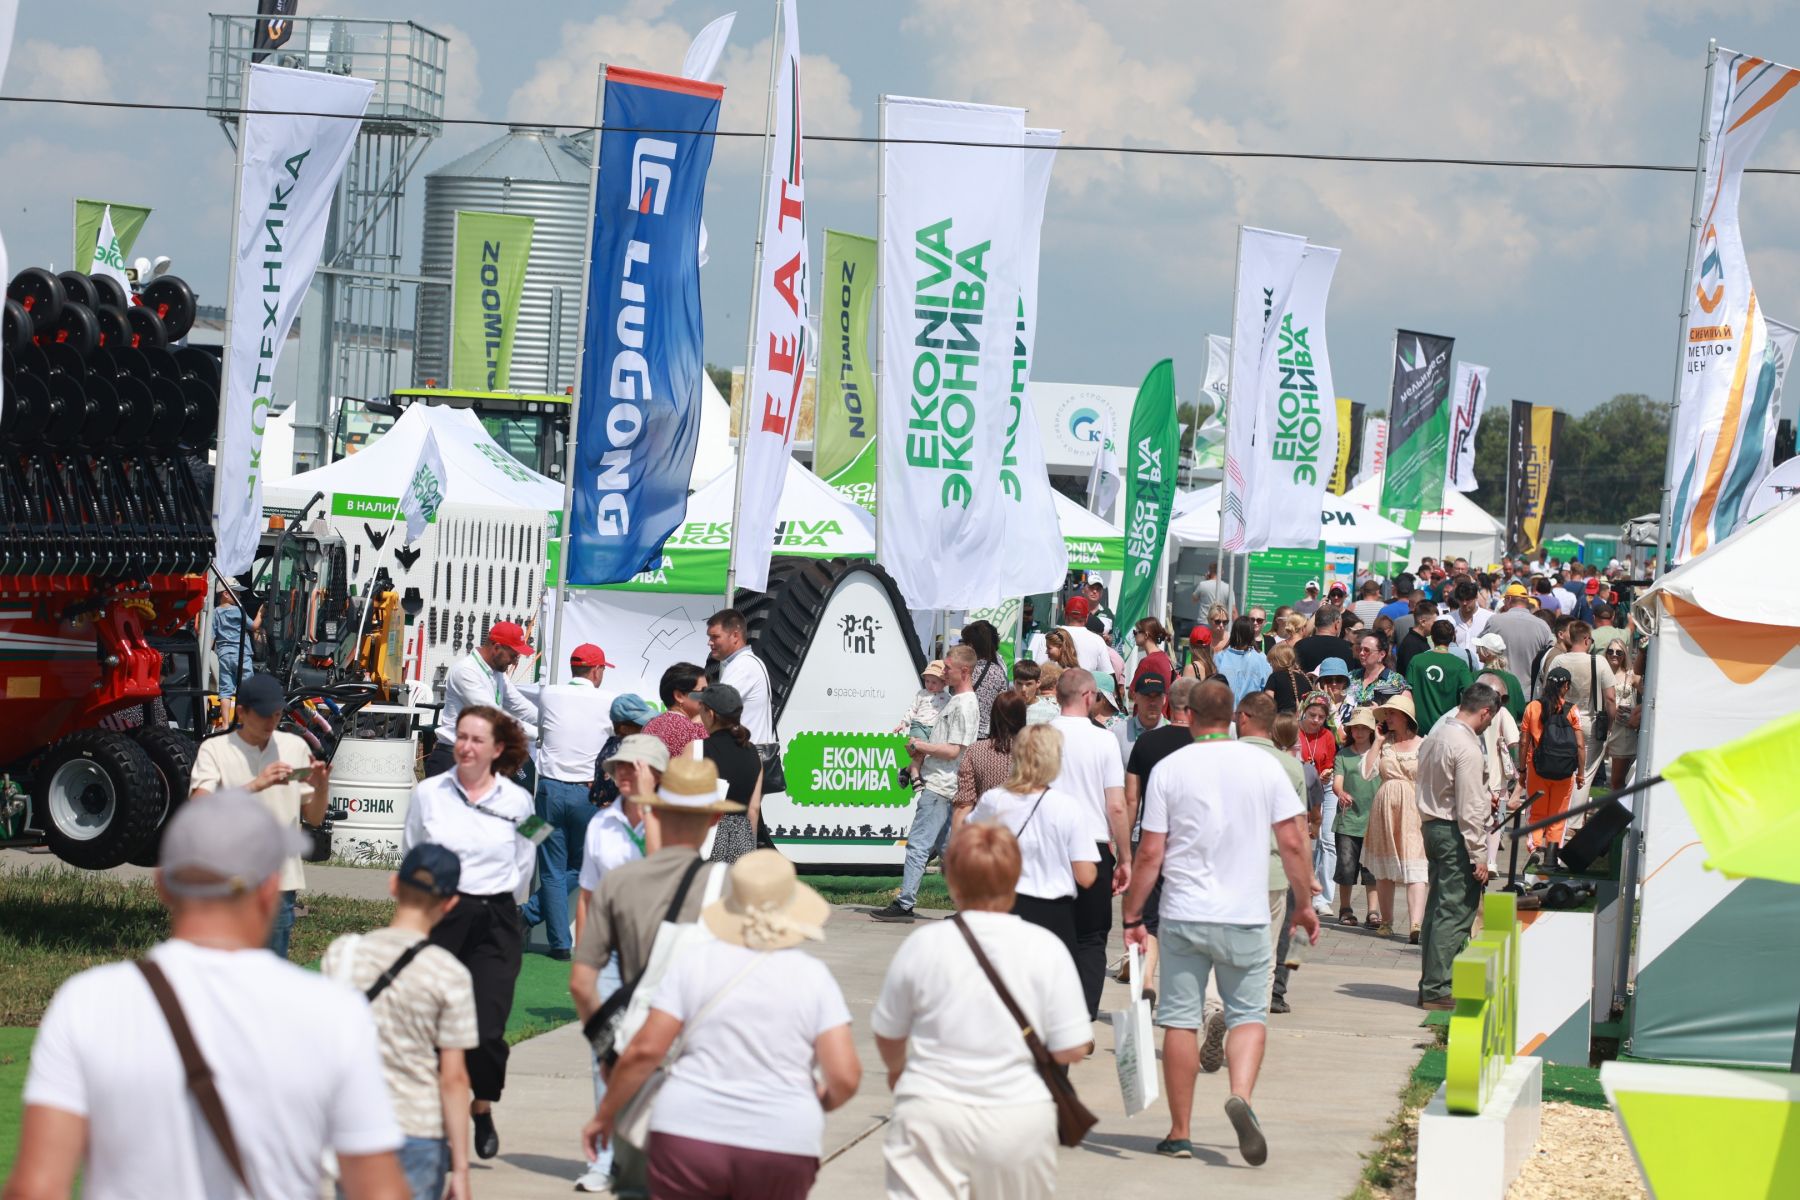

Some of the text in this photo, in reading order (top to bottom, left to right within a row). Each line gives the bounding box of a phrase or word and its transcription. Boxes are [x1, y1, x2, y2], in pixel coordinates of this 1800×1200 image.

[598, 239, 652, 536] LIUGONG
[841, 260, 866, 438] ZOOMLION
[906, 217, 953, 468] EKONIVA
[941, 239, 992, 511] ЭКОНИВА
[1271, 311, 1301, 461] EKONIVA
[1293, 326, 1322, 487] ЭКОНИВА
[346, 499, 354, 510] В
[1127, 437, 1153, 558] EKONIVA
[1134, 447, 1162, 579] ЭКОНИВА
[1158, 478, 1172, 547] СЕМЕНА
[331, 796, 394, 813] АГРОЗНАК
[810, 769, 891, 791] ЭКОНИВА
[823, 747, 897, 769] EKONIVA
